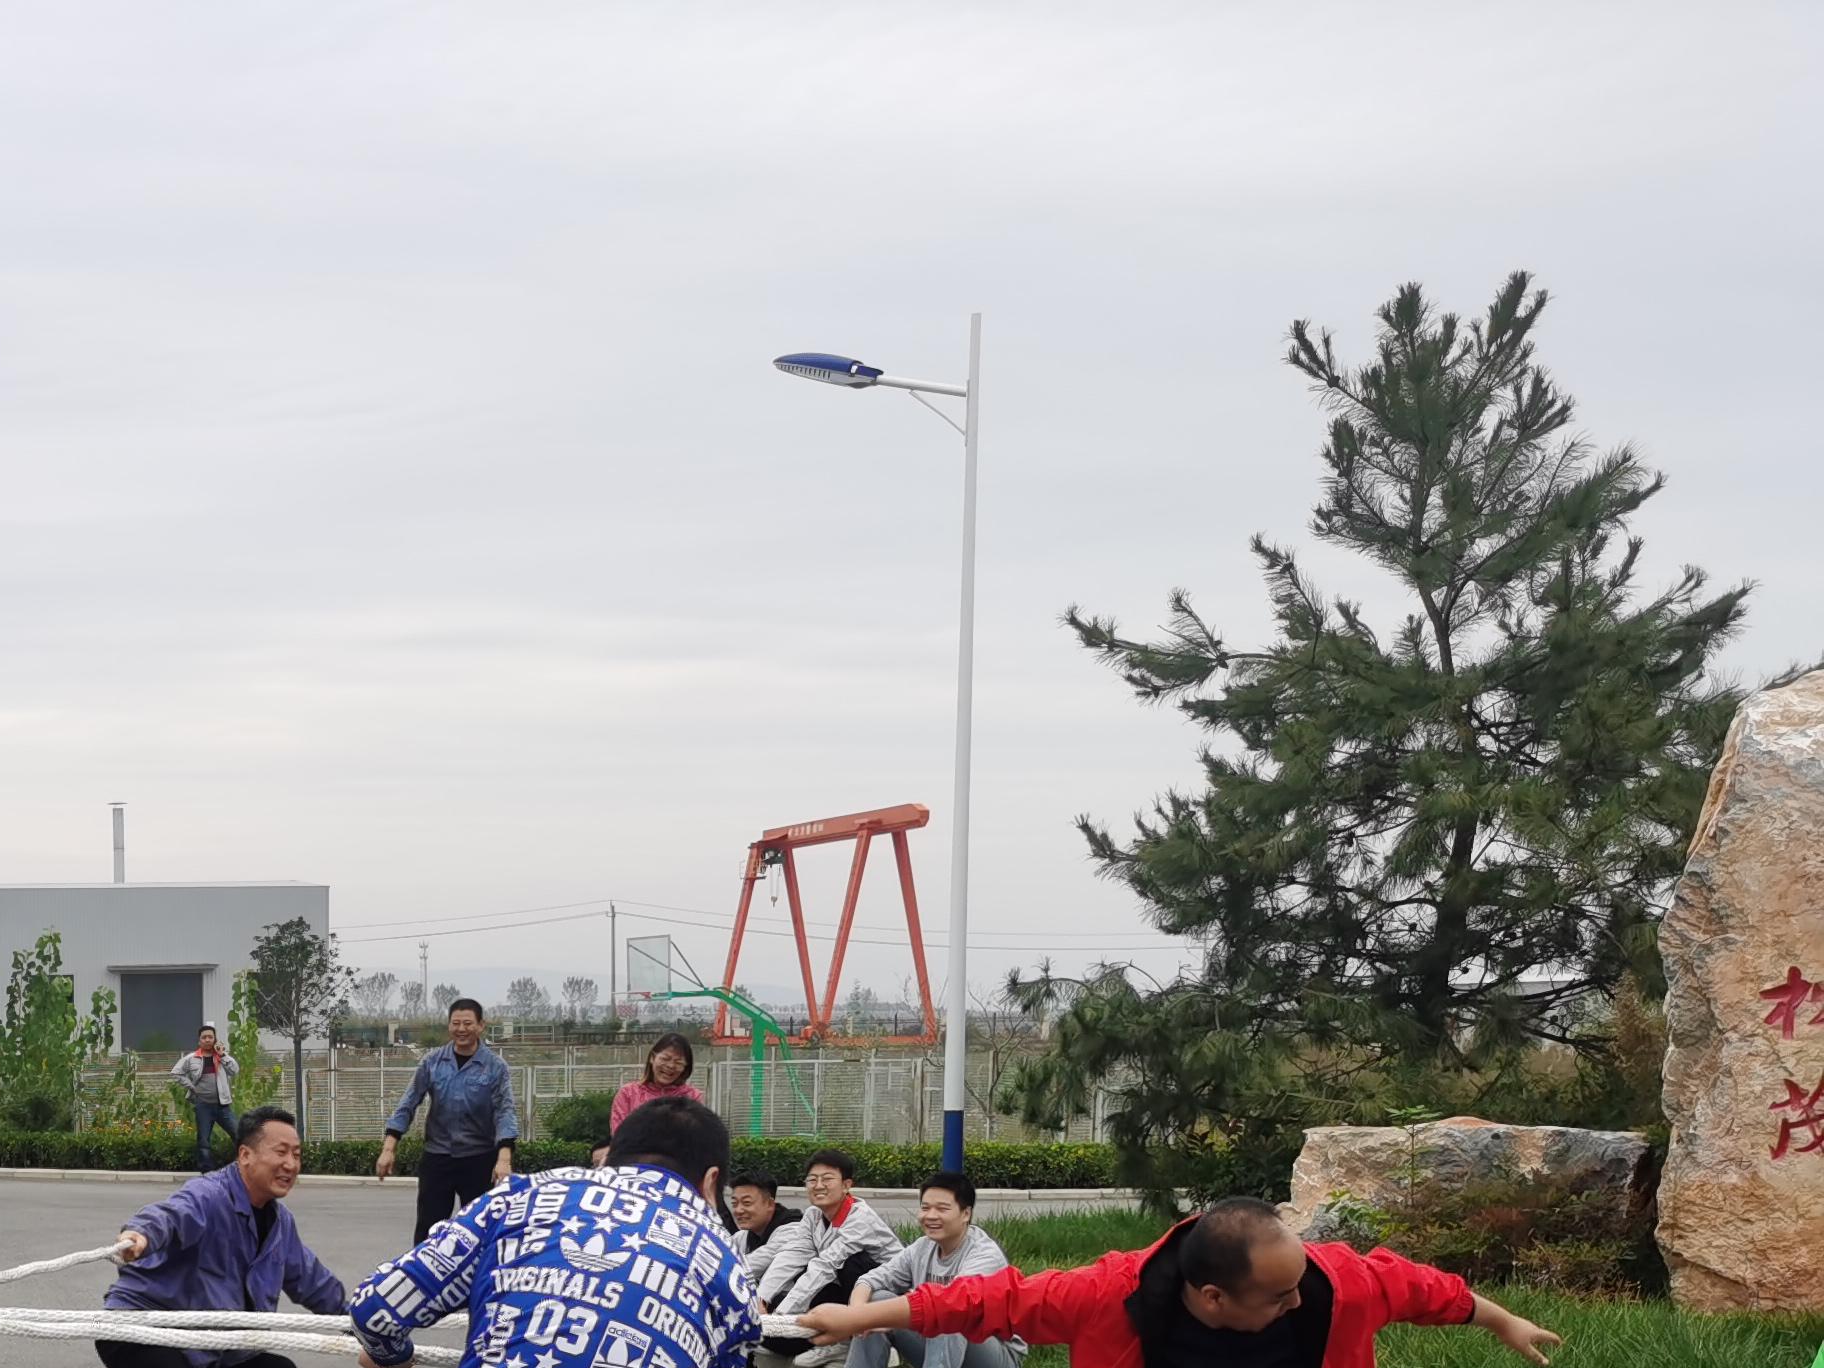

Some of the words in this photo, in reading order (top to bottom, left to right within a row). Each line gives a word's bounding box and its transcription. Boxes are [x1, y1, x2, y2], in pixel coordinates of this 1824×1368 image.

[579, 1185, 649, 1224] 03
[524, 1299, 599, 1356] 03
[607, 1324, 648, 1349] adidas
